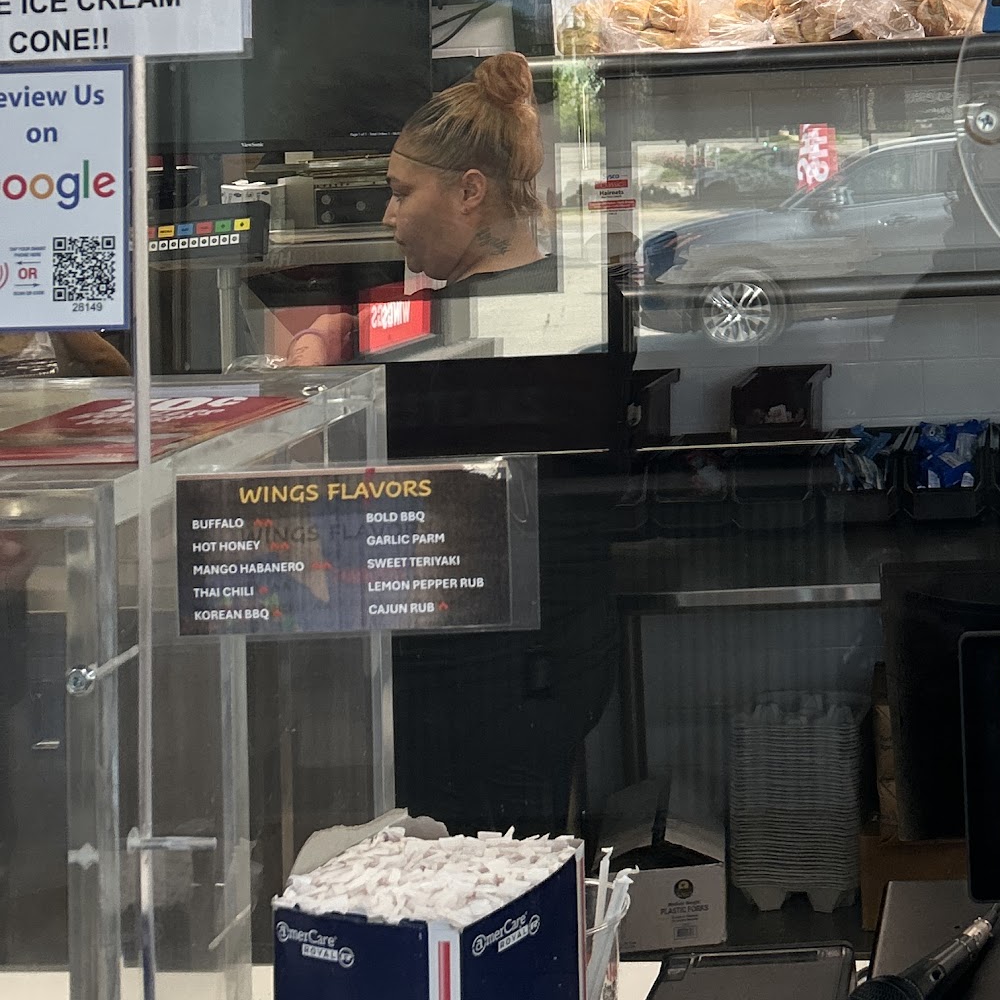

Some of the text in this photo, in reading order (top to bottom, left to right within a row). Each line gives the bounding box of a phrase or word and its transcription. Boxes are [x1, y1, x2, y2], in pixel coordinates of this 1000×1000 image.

[9, 28, 109, 53] CONE!!
[74, 85, 105, 105] Us
[26, 126, 58, 143] on
[18, 268, 37, 279] OR
[72, 303, 103, 312] 28149
[239, 479, 432, 504] WINGS FLAVORS
[366, 511, 425, 523] BOLD BBQ
[192, 518, 244, 530] BUFFALO
[193, 540, 260, 552] HOT HONEY
[367, 533, 444, 546] GARLIC PARM
[193, 561, 304, 575] MANGO HABANERO
[367, 556, 460, 569] SWEET TERIYAKI
[368, 578, 484, 592] LEMON PEPPER RUB
[193, 587, 254, 598] THAI CHILI
[194, 609, 269, 621] KOREAN BBQ
[368, 602, 434, 615] CAJUN RUB
[498, 925, 528, 952] ROYAL
[302, 944, 339, 962] ROYAL
